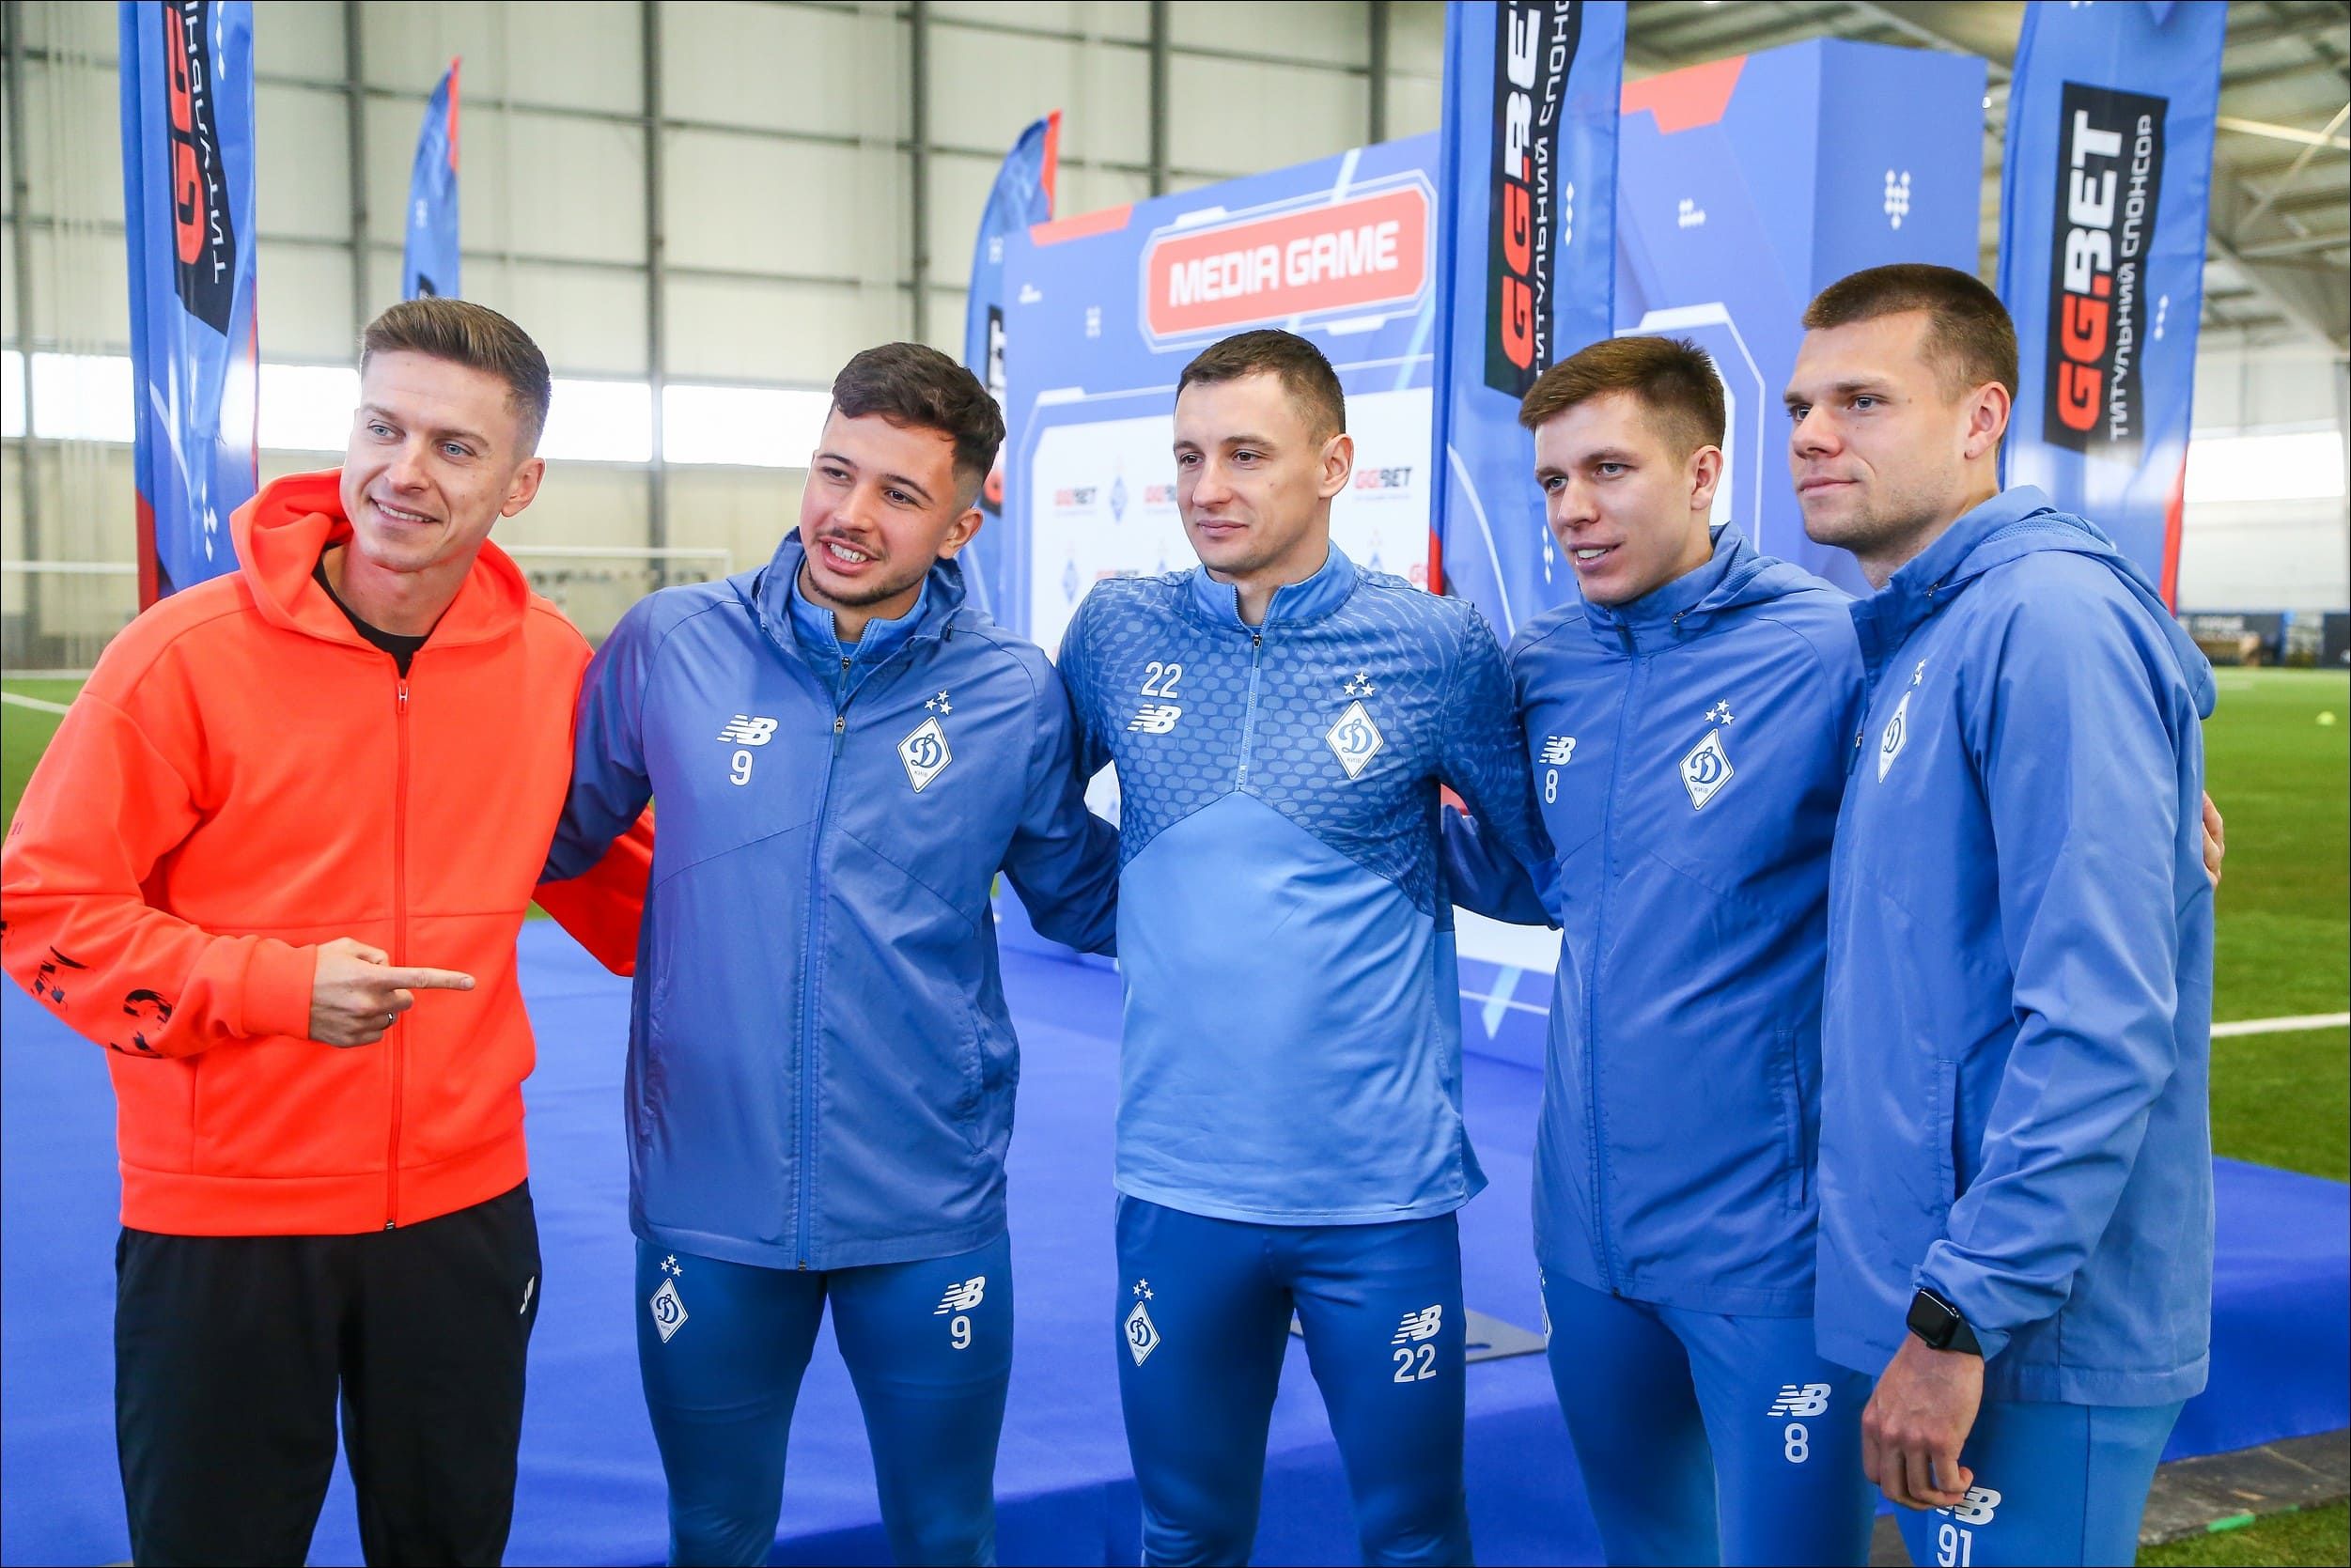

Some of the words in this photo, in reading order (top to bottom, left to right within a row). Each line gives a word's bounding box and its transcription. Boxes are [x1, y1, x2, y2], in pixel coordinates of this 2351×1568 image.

[185, 2, 226, 284] ТИТУЛЬН
[1502, 2, 1541, 370] GG.BE
[2121, 115, 2152, 257] СПОНСОР
[1169, 244, 1280, 307] MEDIA
[1285, 220, 1399, 287] GAME
[2058, 109, 2122, 431] GG.BET
[2110, 262, 2135, 442] ТИТУЛЬНИЙ
[1141, 661, 1183, 699] 22
[729, 750, 754, 786] 9
[1545, 768, 1559, 804] 8
[951, 1315, 973, 1350] 9
[1393, 1344, 1437, 1383] 22
[1784, 1422, 1809, 1464] 8
[1937, 1523, 1972, 1567] 91
